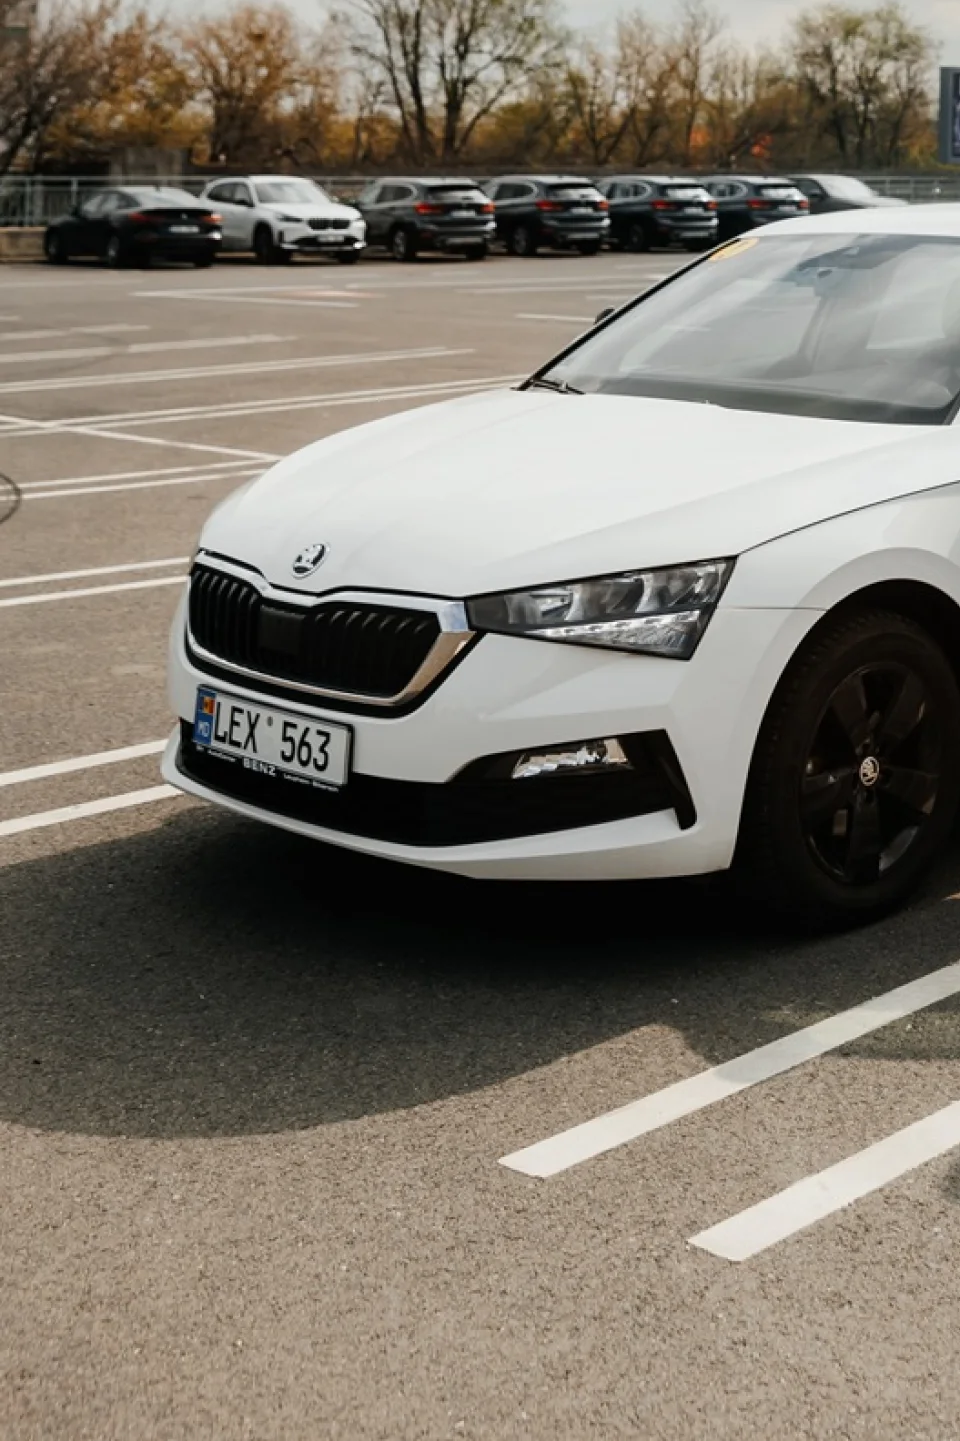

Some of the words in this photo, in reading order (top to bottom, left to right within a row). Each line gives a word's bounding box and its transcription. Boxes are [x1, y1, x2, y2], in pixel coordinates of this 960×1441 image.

[214, 701, 261, 753] LEX
[280, 720, 331, 772] 563
[243, 757, 276, 777] BENZ
